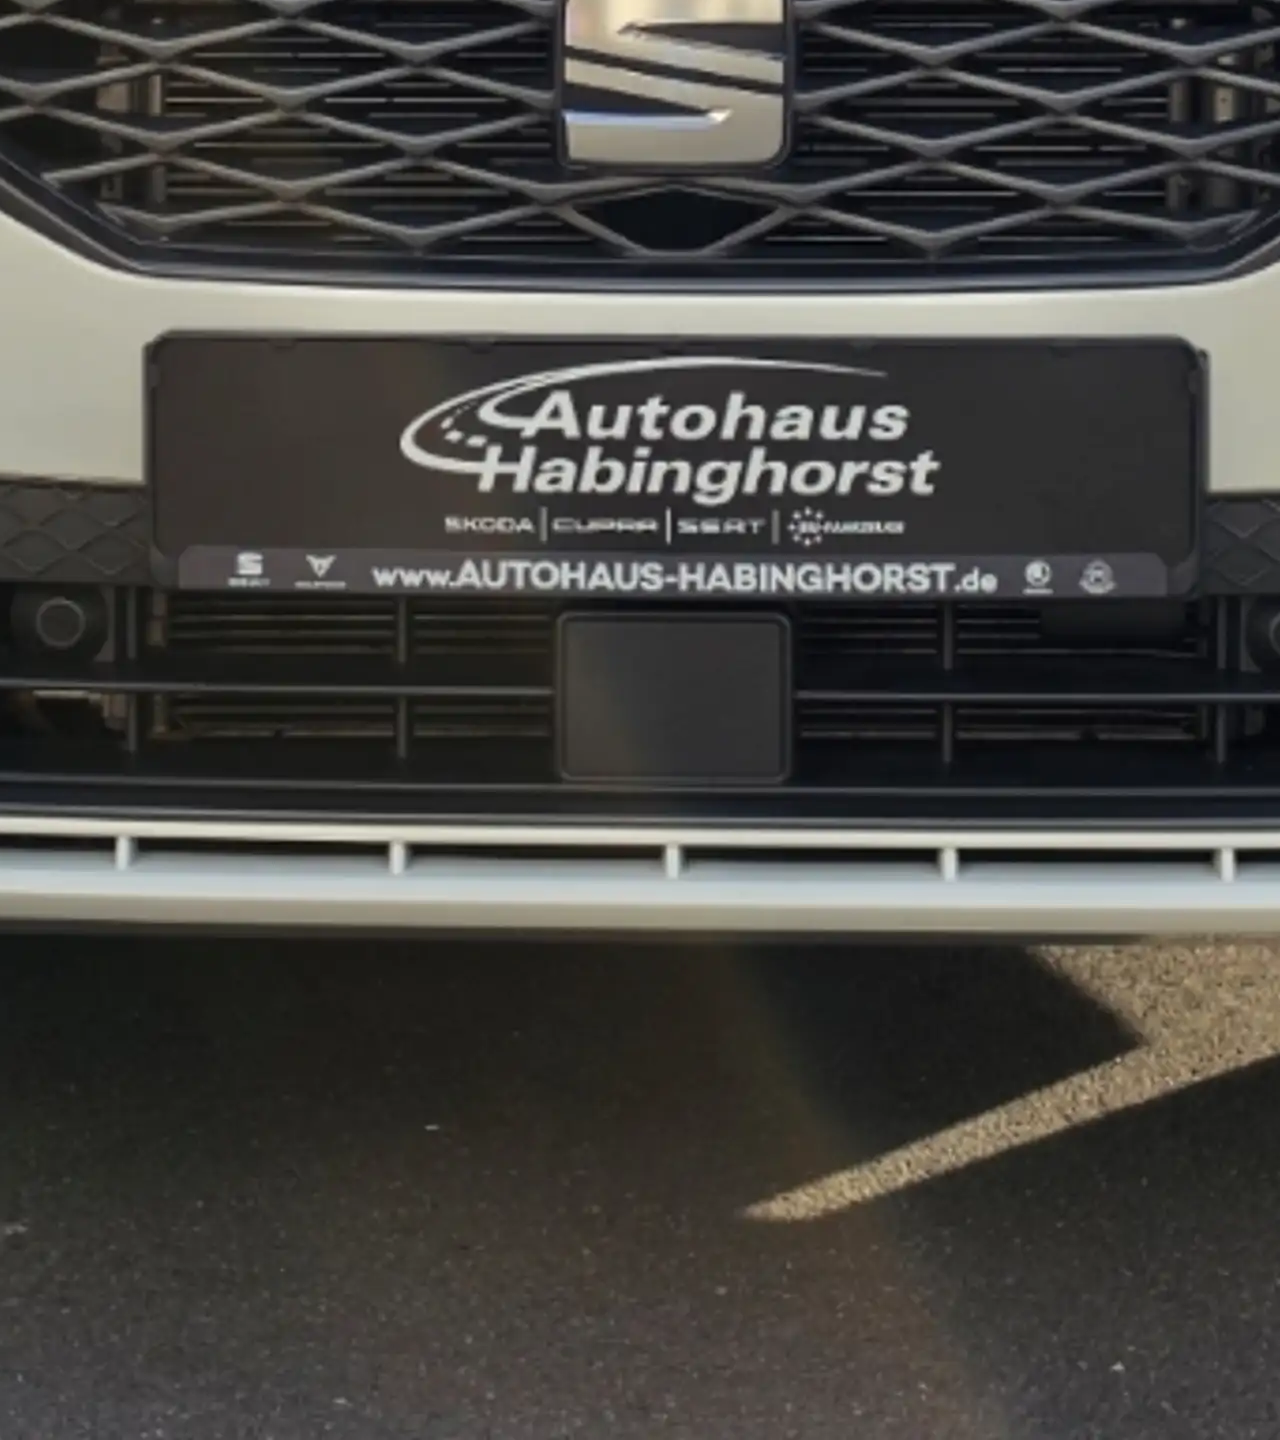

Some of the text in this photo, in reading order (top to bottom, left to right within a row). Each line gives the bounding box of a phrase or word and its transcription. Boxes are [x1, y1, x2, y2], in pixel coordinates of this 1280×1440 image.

[519, 390, 910, 441] Autohaus
[476, 444, 941, 506] Habinghorst
[372, 558, 999, 594] www.AUTOHAUS-HABINGHORST.de
